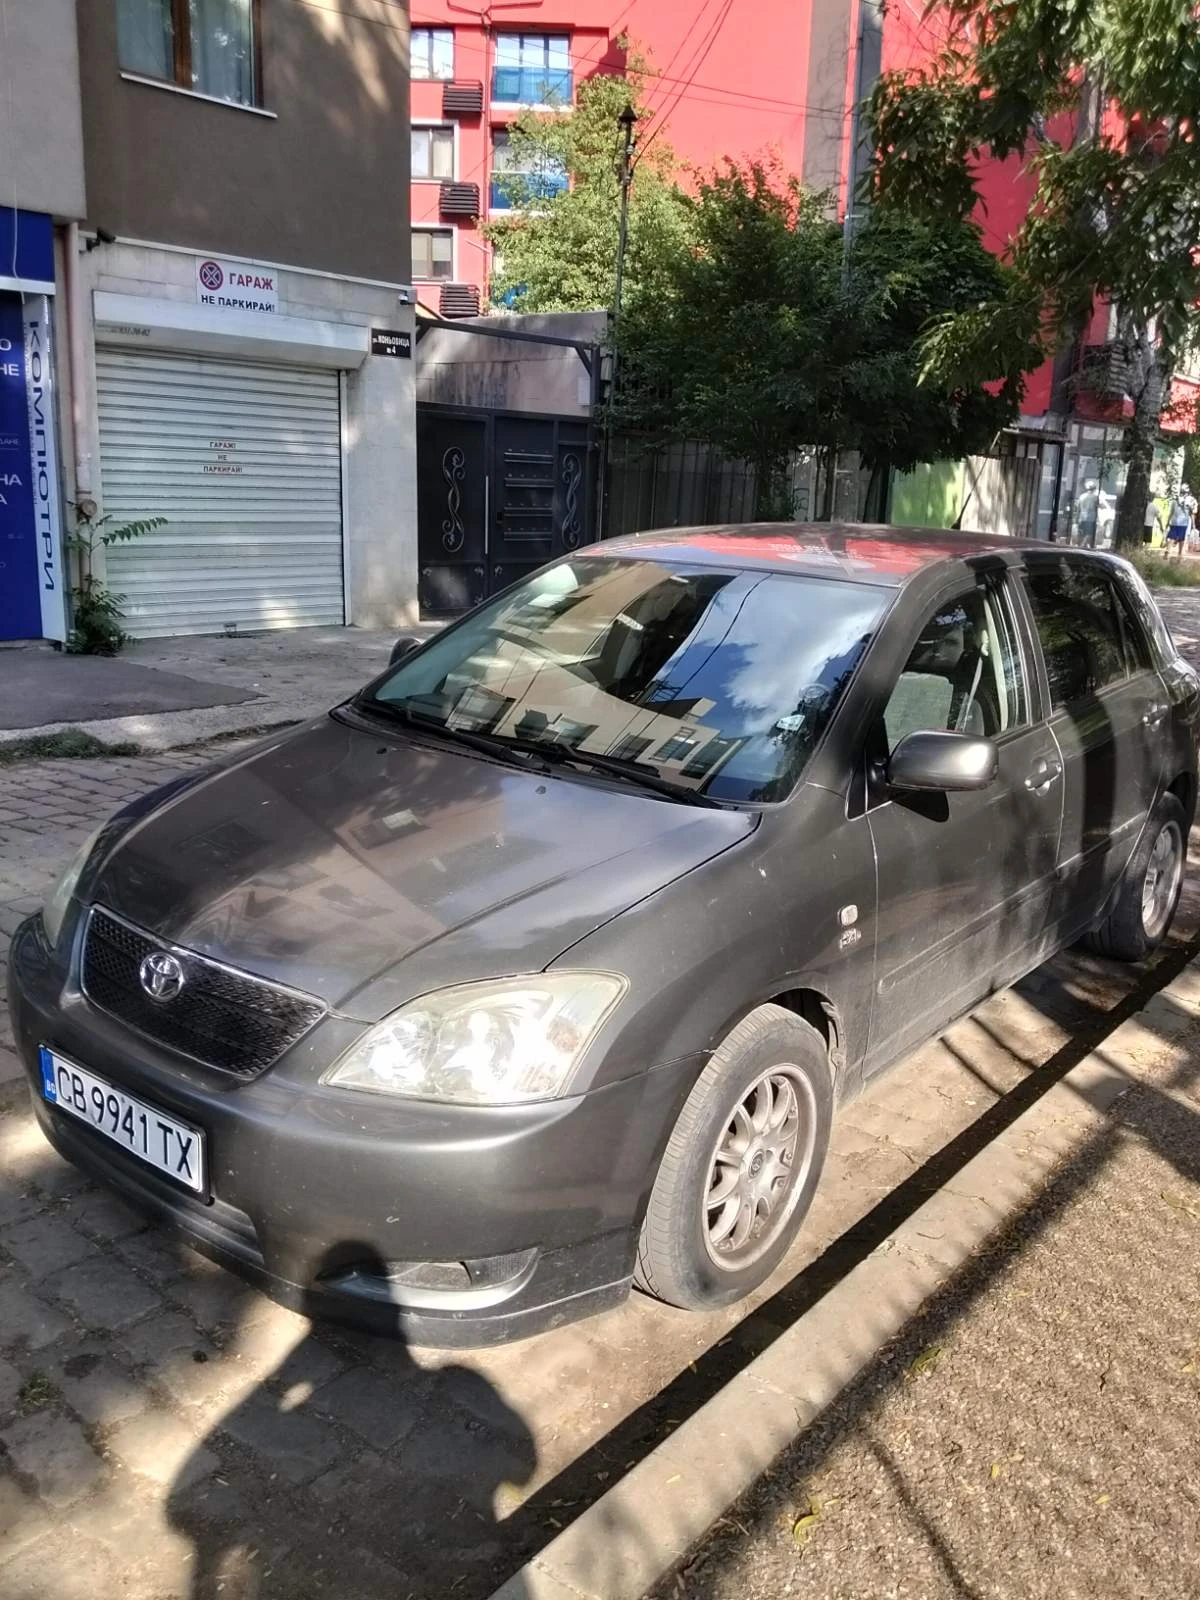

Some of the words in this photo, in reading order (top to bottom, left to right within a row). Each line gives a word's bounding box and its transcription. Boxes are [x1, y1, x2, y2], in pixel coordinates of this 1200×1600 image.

[229, 272, 274, 291] ГАРАЖ
[201, 294, 215, 305] НЕ
[218, 296, 275, 313] ПАРКИРАЙ!
[30, 321, 54, 590] КОМПЮТРИ
